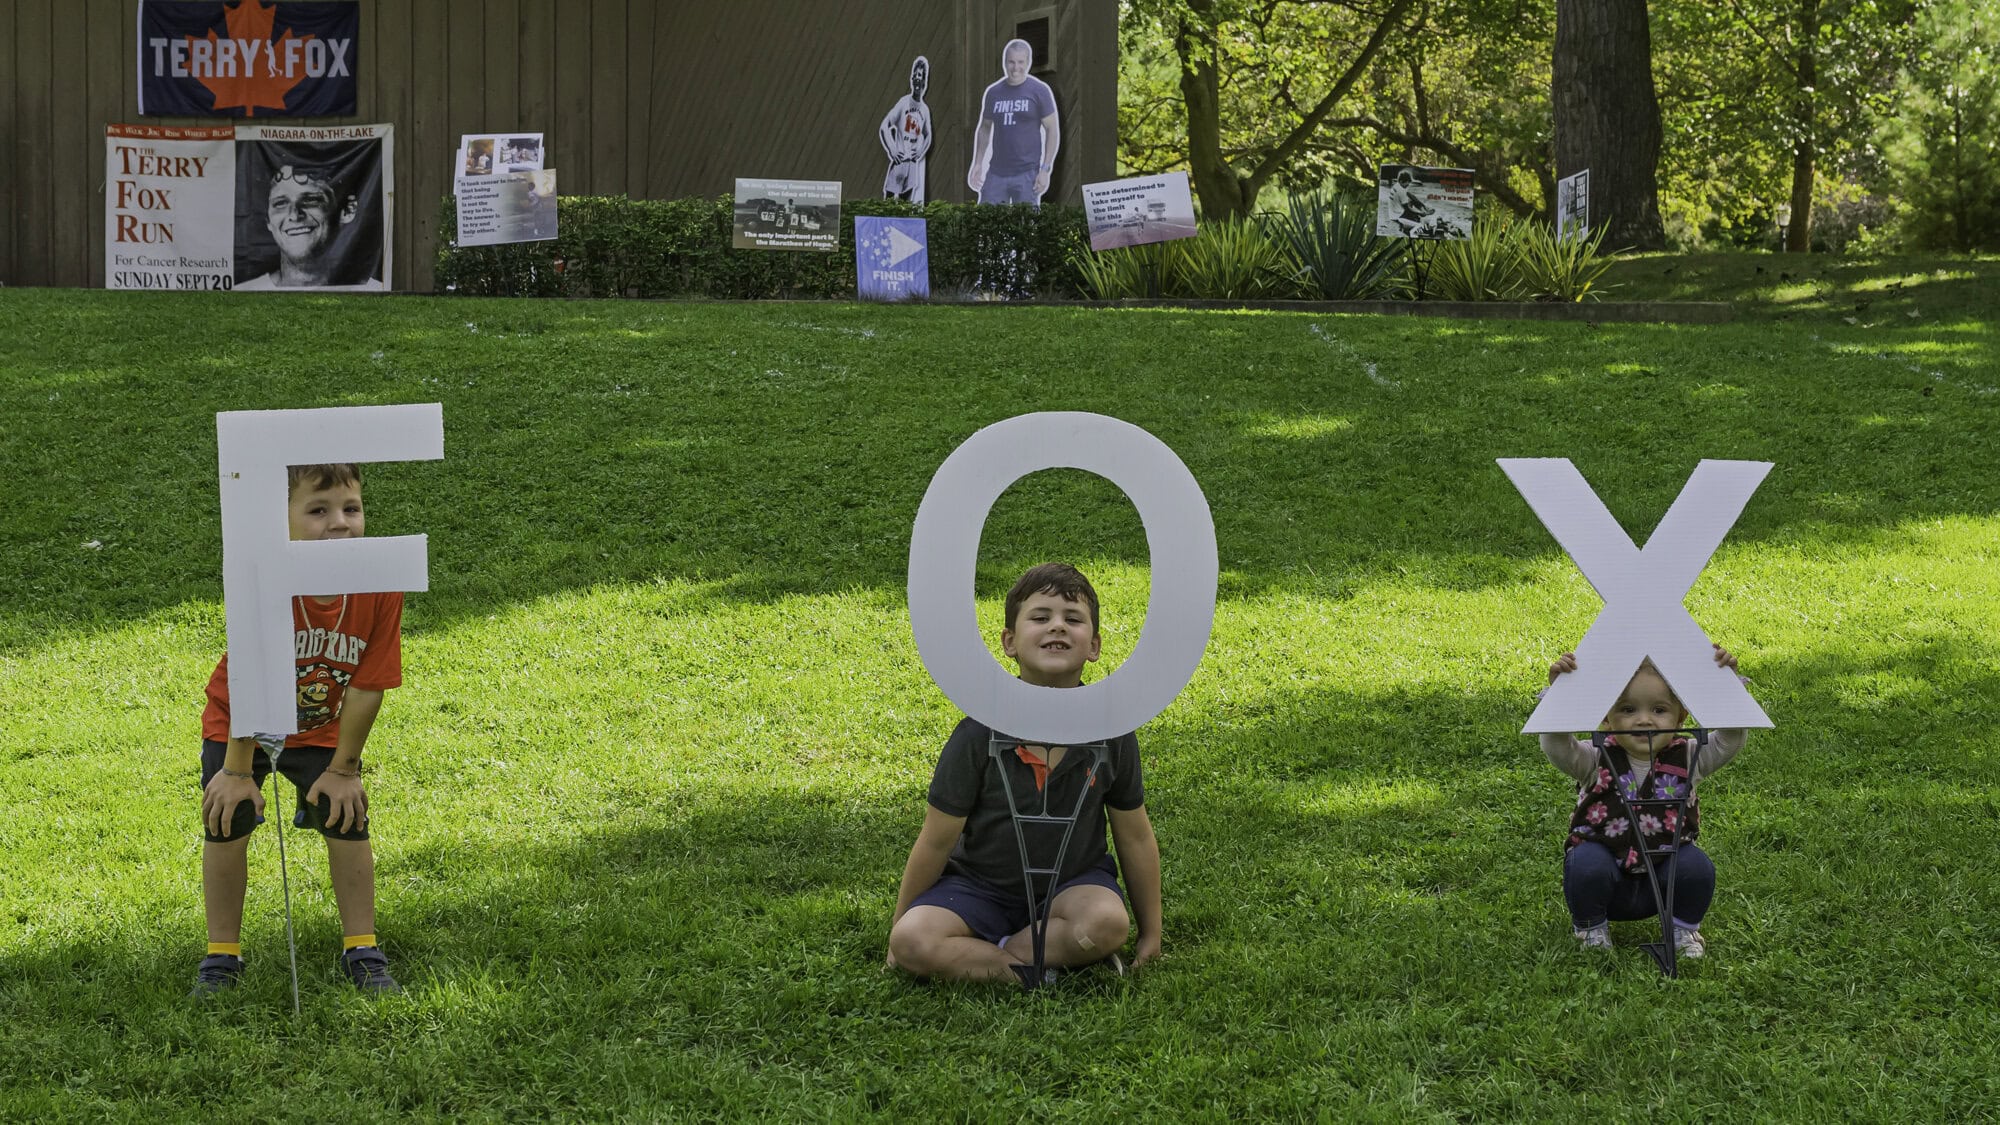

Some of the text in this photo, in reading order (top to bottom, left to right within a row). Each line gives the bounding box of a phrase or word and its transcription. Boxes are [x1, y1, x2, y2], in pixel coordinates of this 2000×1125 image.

[150, 38, 351, 78] TERRY FOX
[993, 99, 1029, 114] FINISH
[1003, 113, 1017, 126] IT.
[260, 127, 375, 140] NIAGARA-ON-THE-LAKE
[115, 146, 209, 178] TERRY
[115, 180, 172, 210] FOX
[1094, 190, 1110, 198] was
[1111, 183, 1156, 195] determined
[1091, 198, 1109, 206] take
[1110, 195, 1136, 204] myself
[1093, 204, 1126, 214] the limit
[1094, 213, 1122, 222] for this
[115, 214, 174, 244] RUN
[758, 231, 774, 239] only
[774, 232, 811, 240] important
[811, 233, 827, 241] part
[115, 254, 228, 268] For Cancer Research
[114, 271, 233, 291] SUNDAY SEPT 20
[872, 270, 914, 282] FINISH
[887, 281, 901, 292] IT.
